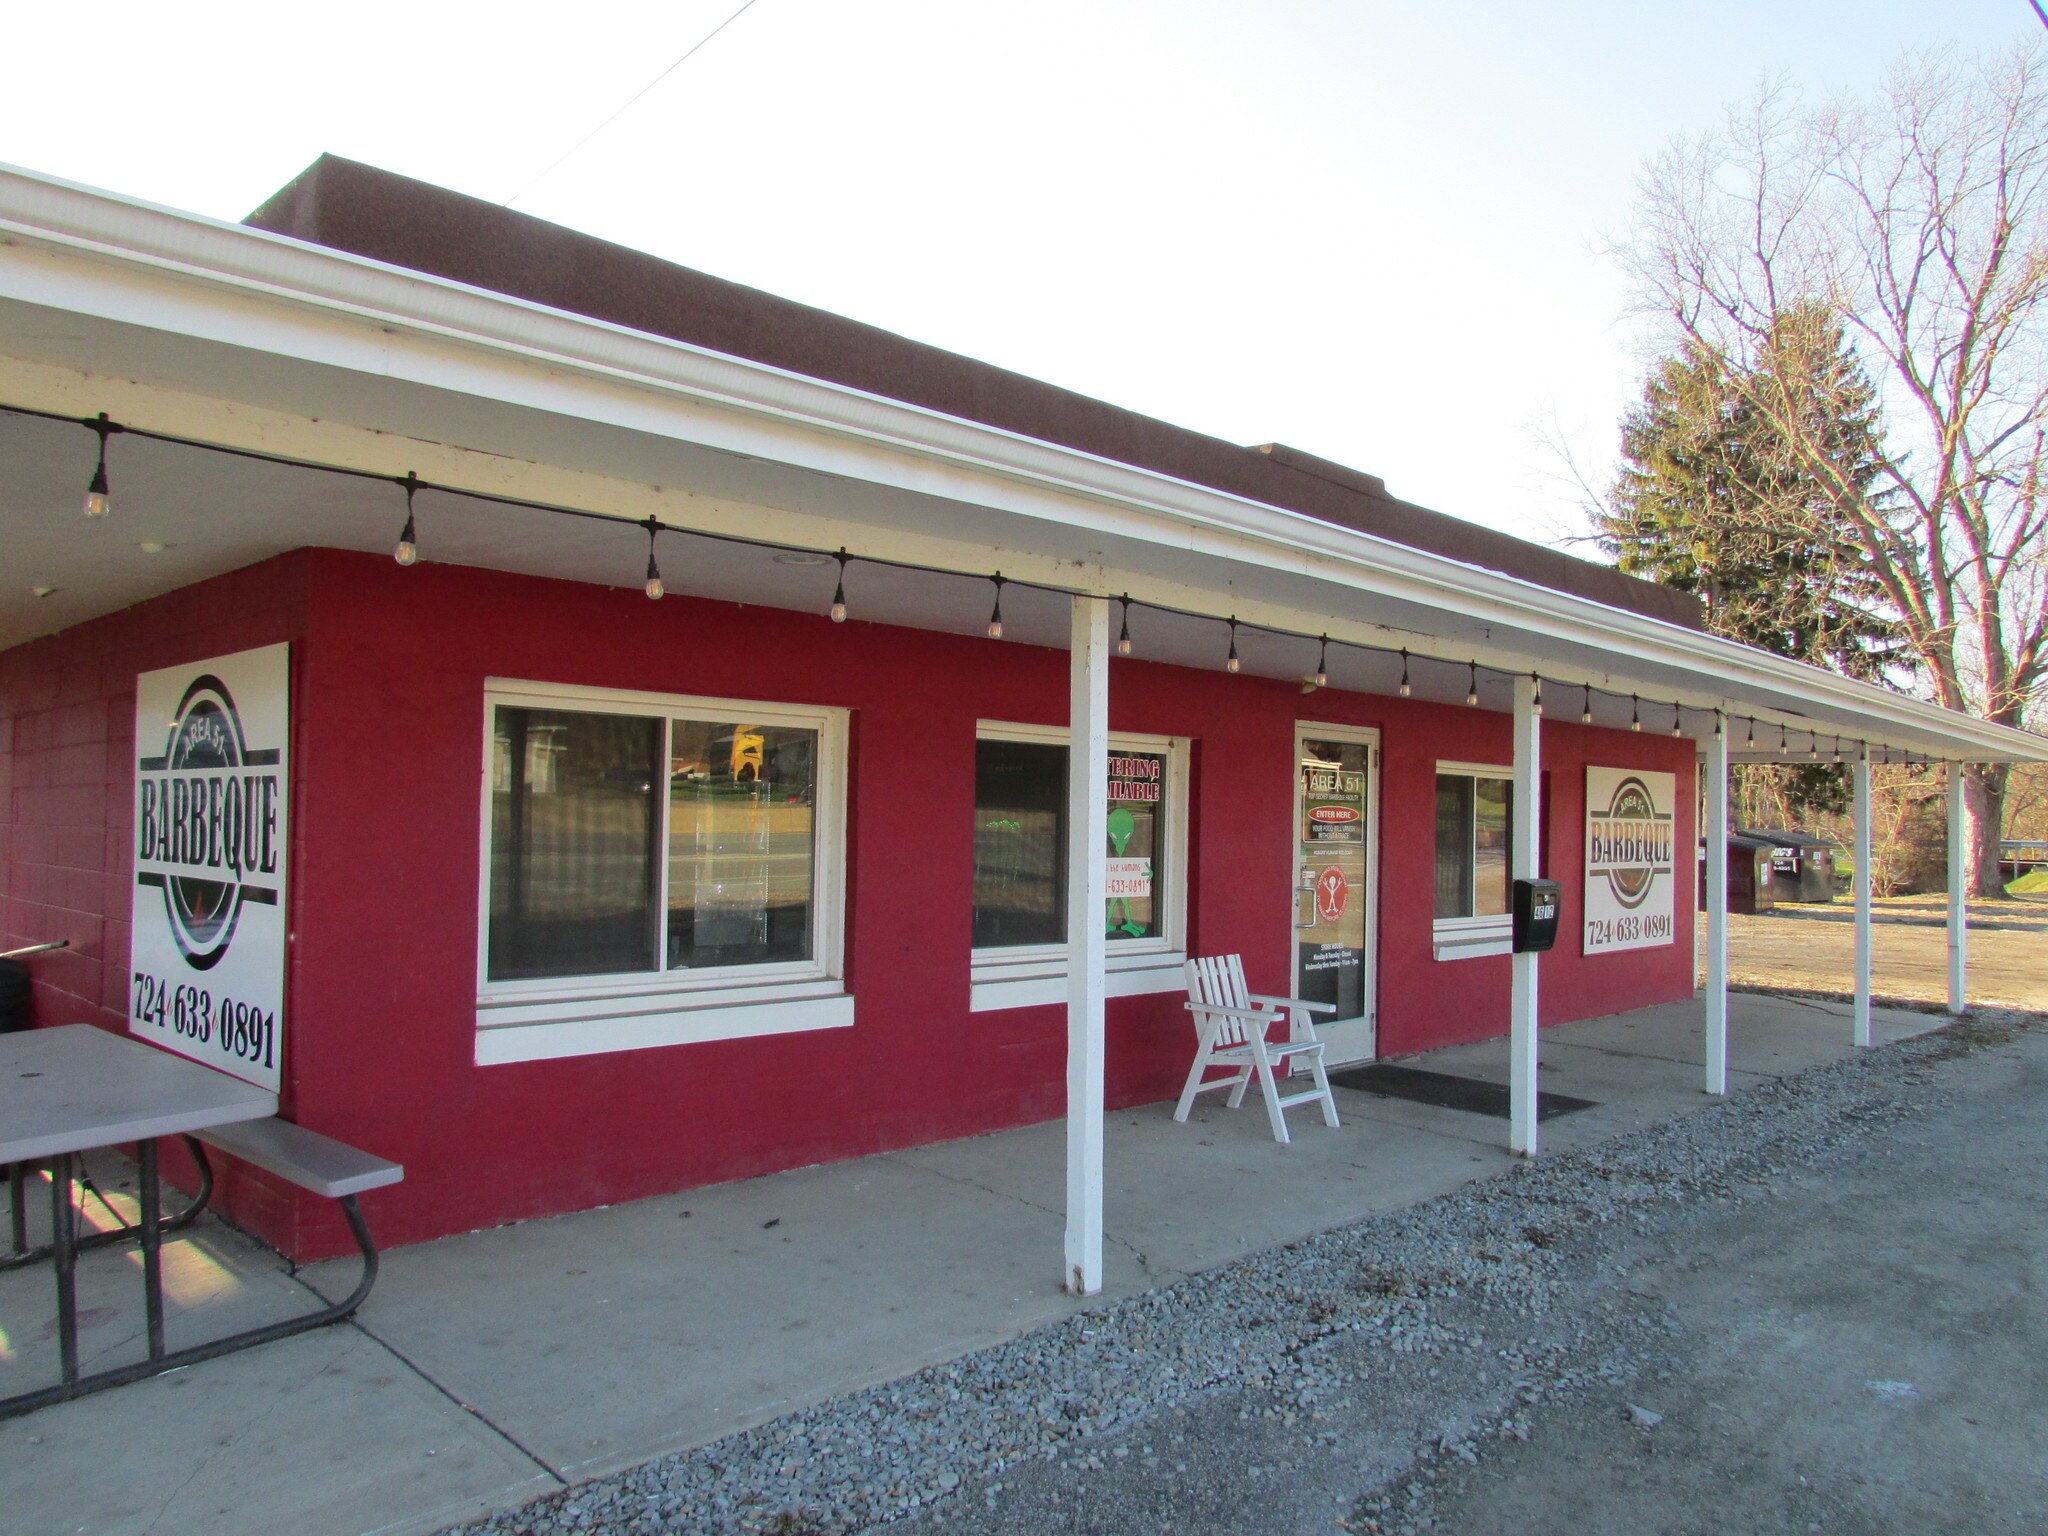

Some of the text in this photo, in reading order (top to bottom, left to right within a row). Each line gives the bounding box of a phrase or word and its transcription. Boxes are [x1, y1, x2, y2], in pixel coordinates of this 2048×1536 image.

[185, 716, 225, 759] AREA 51
[1106, 757, 1160, 778] TERING
[1310, 774, 1343, 791] AREA
[1619, 795, 1645, 813] AREA 51
[1316, 810, 1351, 819] ENTER HERE
[140, 774, 279, 882] BARBEQUE
[1590, 821, 1671, 866] BARBEQUE
[1106, 879, 1145, 893] -633-0891
